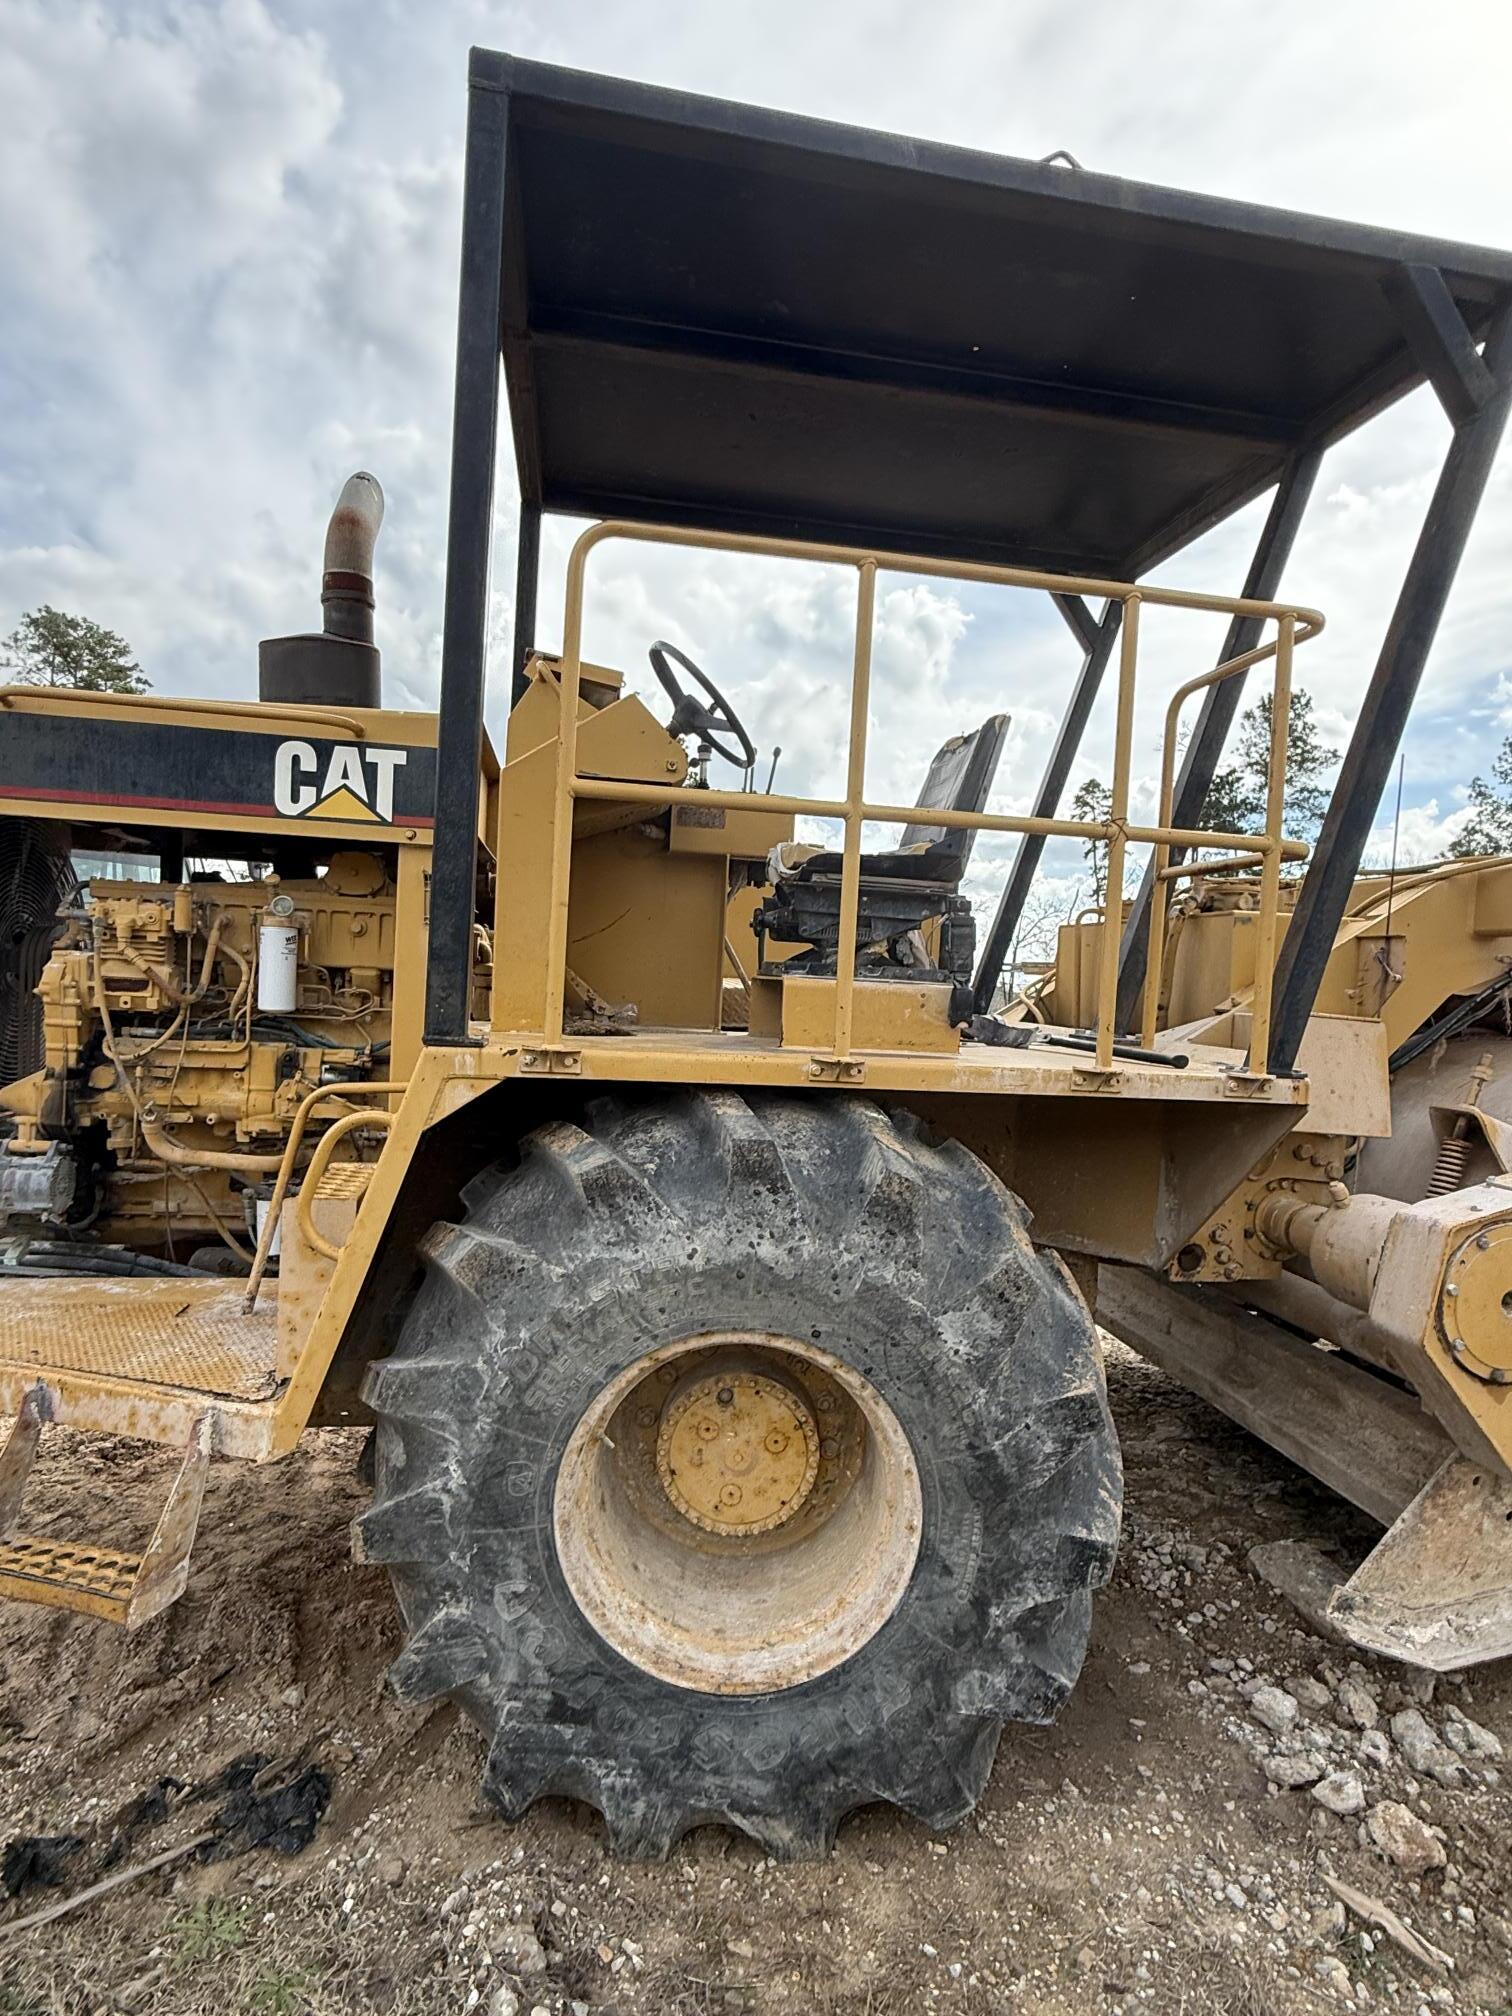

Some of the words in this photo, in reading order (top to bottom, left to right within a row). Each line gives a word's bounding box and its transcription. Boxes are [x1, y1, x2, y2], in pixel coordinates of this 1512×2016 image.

[274, 740, 407, 823] CAT
[494, 1246, 706, 1410] FORESTR
[523, 1294, 634, 1412] SPECAL
